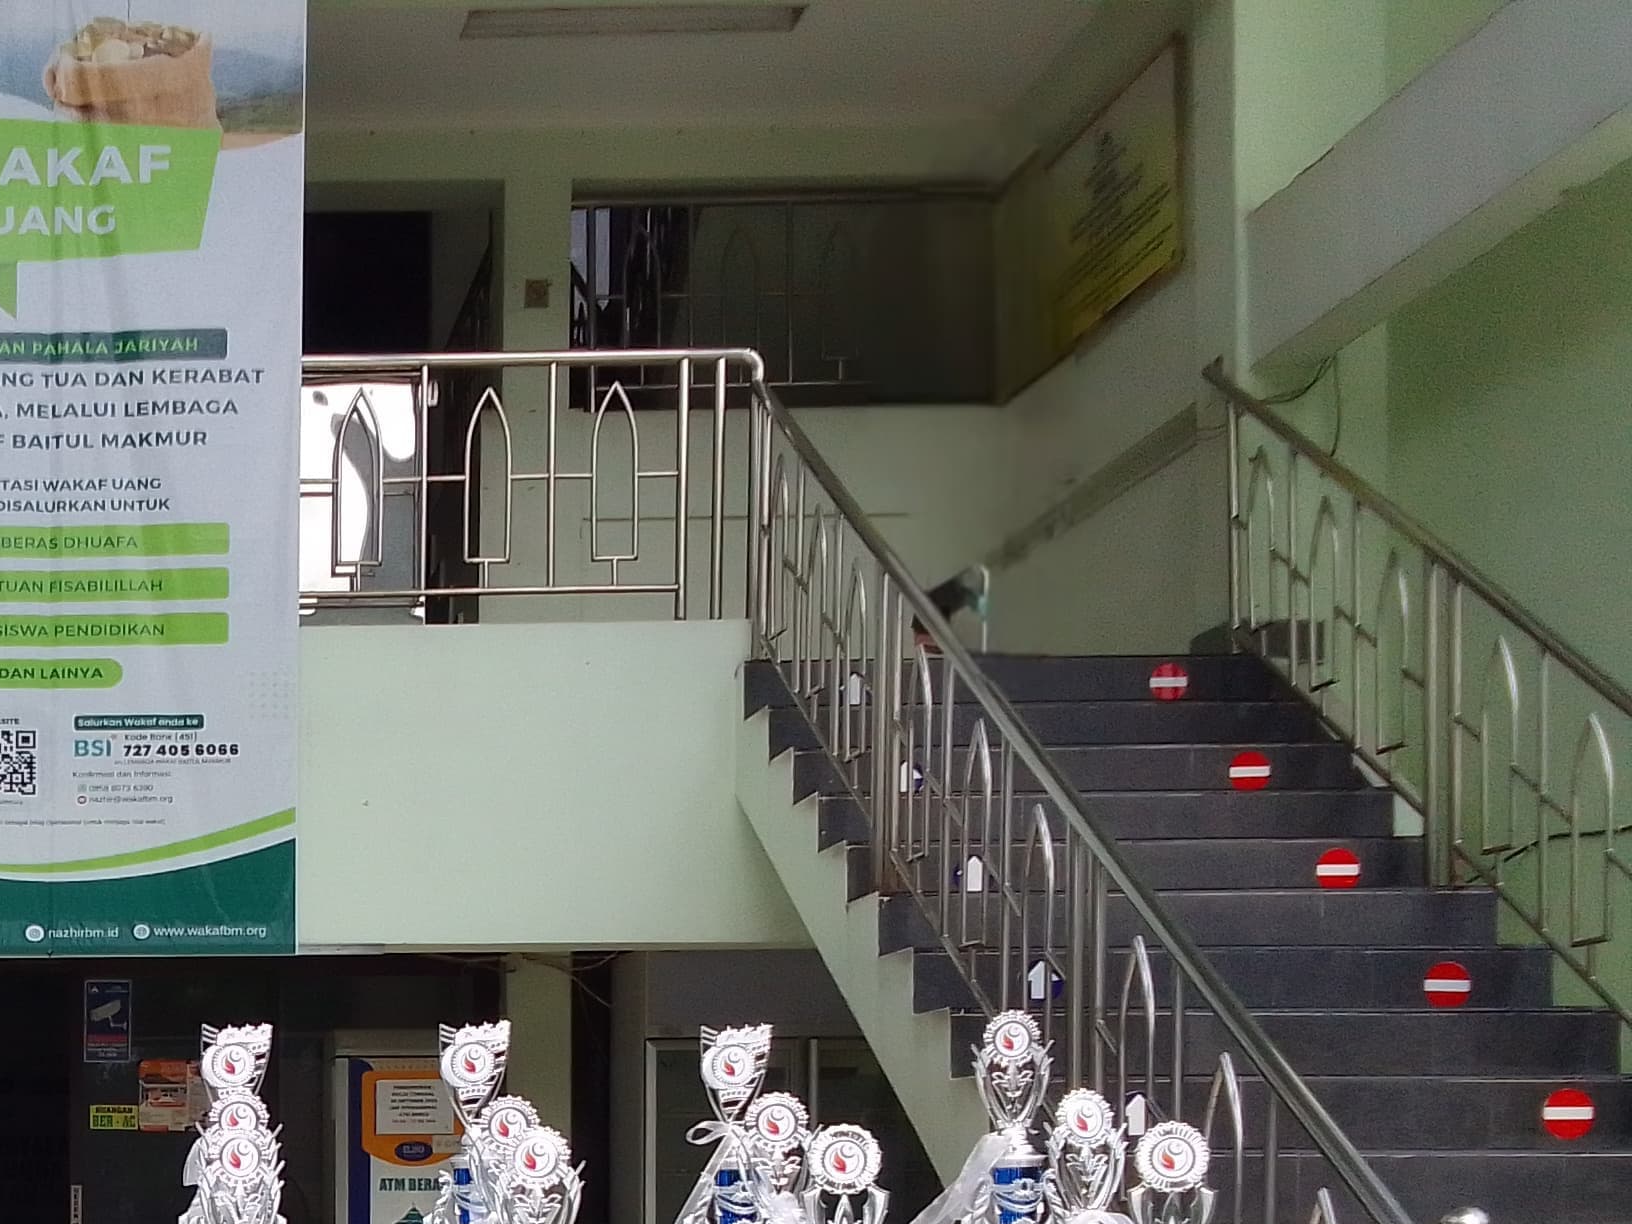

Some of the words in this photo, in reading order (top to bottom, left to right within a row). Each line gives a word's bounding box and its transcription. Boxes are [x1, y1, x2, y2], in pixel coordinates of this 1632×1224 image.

[32, 339, 109, 355] PAHALA
[115, 338, 198, 354] JARIYAH
[41, 371, 88, 388] TUA
[95, 370, 144, 386] DAN
[152, 368, 265, 385] KERABAT
[16, 402, 116, 419] MELALUI
[124, 400, 238, 417] LEMBAGA
[12, 433, 94, 449] BAITUL
[101, 431, 207, 448] MAKMUR
[42, 478, 108, 492] WAKAF
[112, 477, 162, 491] UANG
[111, 498, 170, 511] UNTUK
[1, 536, 58, 549] BERAS
[63, 535, 137, 549] DHUAFA
[49, 579, 163, 593] FISABILILLAH
[54, 623, 164, 637] PENDIDIKAN
[40, 666, 103, 680] LAINYA
[78, 718, 122, 727] Salurkan
[124, 717, 156, 727] Wakaf
[186, 717, 199, 726] ke
[124, 733, 148, 741] Kode
[74, 740, 111, 757] BSI
[123, 745, 151, 757] 727
[156, 744, 190, 756] 405
[195, 744, 239, 756] 6066
[47, 925, 119, 940] nazhirbm.id
[153, 923, 266, 939] www.wakafbm.org
[379, 1177, 406, 1191] ATM
[408, 1177, 444, 1191] BERA
